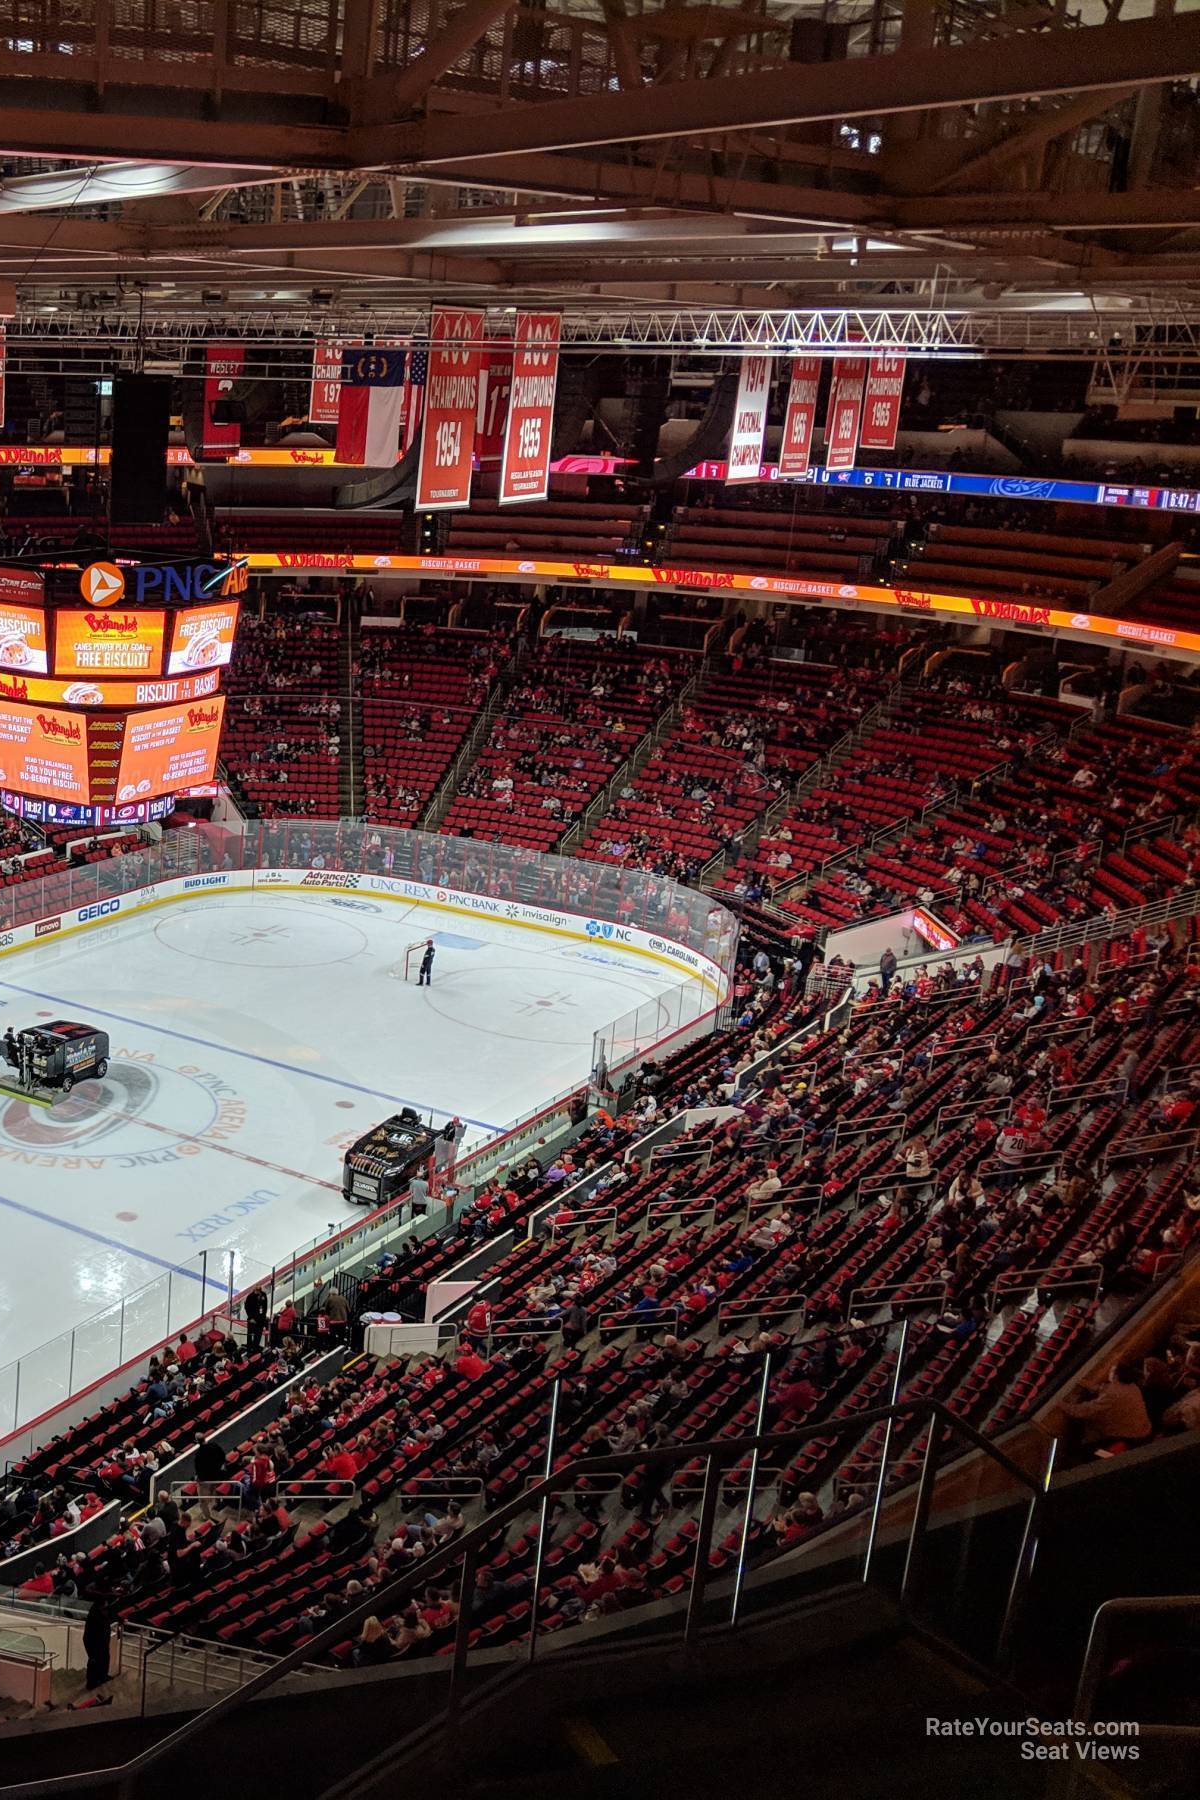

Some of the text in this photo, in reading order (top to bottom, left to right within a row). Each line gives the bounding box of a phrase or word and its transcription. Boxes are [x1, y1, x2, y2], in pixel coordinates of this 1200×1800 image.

[429, 376, 477, 409] CHAMPIONS
[512, 376, 554, 409] CHAMPIONS
[869, 377, 902, 395] CHAMPIONS
[738, 412, 762, 433] NATIONAL
[435, 421, 462, 466] 1954
[518, 418, 542, 458] 1955
[290, 450, 324, 464] Bojangles
[731, 445, 761, 466] CHAMPIONS
[904, 478, 944, 490] BLUE JACKETS
[1169, 493, 1190, 508] 6:47
[421, 559, 481, 570] BISCUIT BASKET
[134, 564, 215, 602] PNC
[773, 581, 834, 595] BISCUIT BASKET
[84, 612, 138, 633] Bojangles
[180, 621, 198, 637] FREE
[200, 616, 233, 634] BISCUIT!
[1117, 624, 1176, 643] BISCUIT BASKET
[74, 643, 91, 651] CANES
[93, 643, 113, 651] POWER
[114, 643, 130, 651] PLAY
[76, 651, 150, 668] FREE BISCUIT!
[136, 683, 179, 703] BISCUIT
[12, 716, 23, 724] PUT
[187, 705, 219, 727] Bojangles
[8, 722, 32, 734] BASKET
[36, 713, 81, 740] Bojangles
[14, 734, 27, 743] PLAY
[24, 756, 73, 771] HEAD BOJANGLES
[26, 765, 74, 780] FOR YOUR FREE
[20, 772, 51, 785] BO-BERRY
[53, 777, 81, 791] BISCUIT!
[48, 804, 57, 817] 0
[137, 804, 145, 817] 0
[184, 875, 228, 888] BUD LIGHT
[300, 878, 320, 887] Auto
[321, 879, 344, 887] Parts
[305, 871, 346, 882] Advance
[140, 885, 156, 896] DNA
[370, 878, 432, 899] UNC REX
[78, 899, 121, 922] GEICO
[522, 907, 568, 927] invisalign
[36, 919, 61, 934] Lenovo
[615, 928, 632, 942] NC
[651, 941, 665, 951] FOX
[666, 945, 699, 968] CAROLINAS
[195, 1071, 247, 1141] PNC ARENA
[391, 1133, 413, 1144] LBC
[1009, 1137, 1025, 1150] 20
[120, 1149, 182, 1169] PNC
[176, 1189, 281, 1244] UNC REX
[317, 1317, 326, 1329] 53
